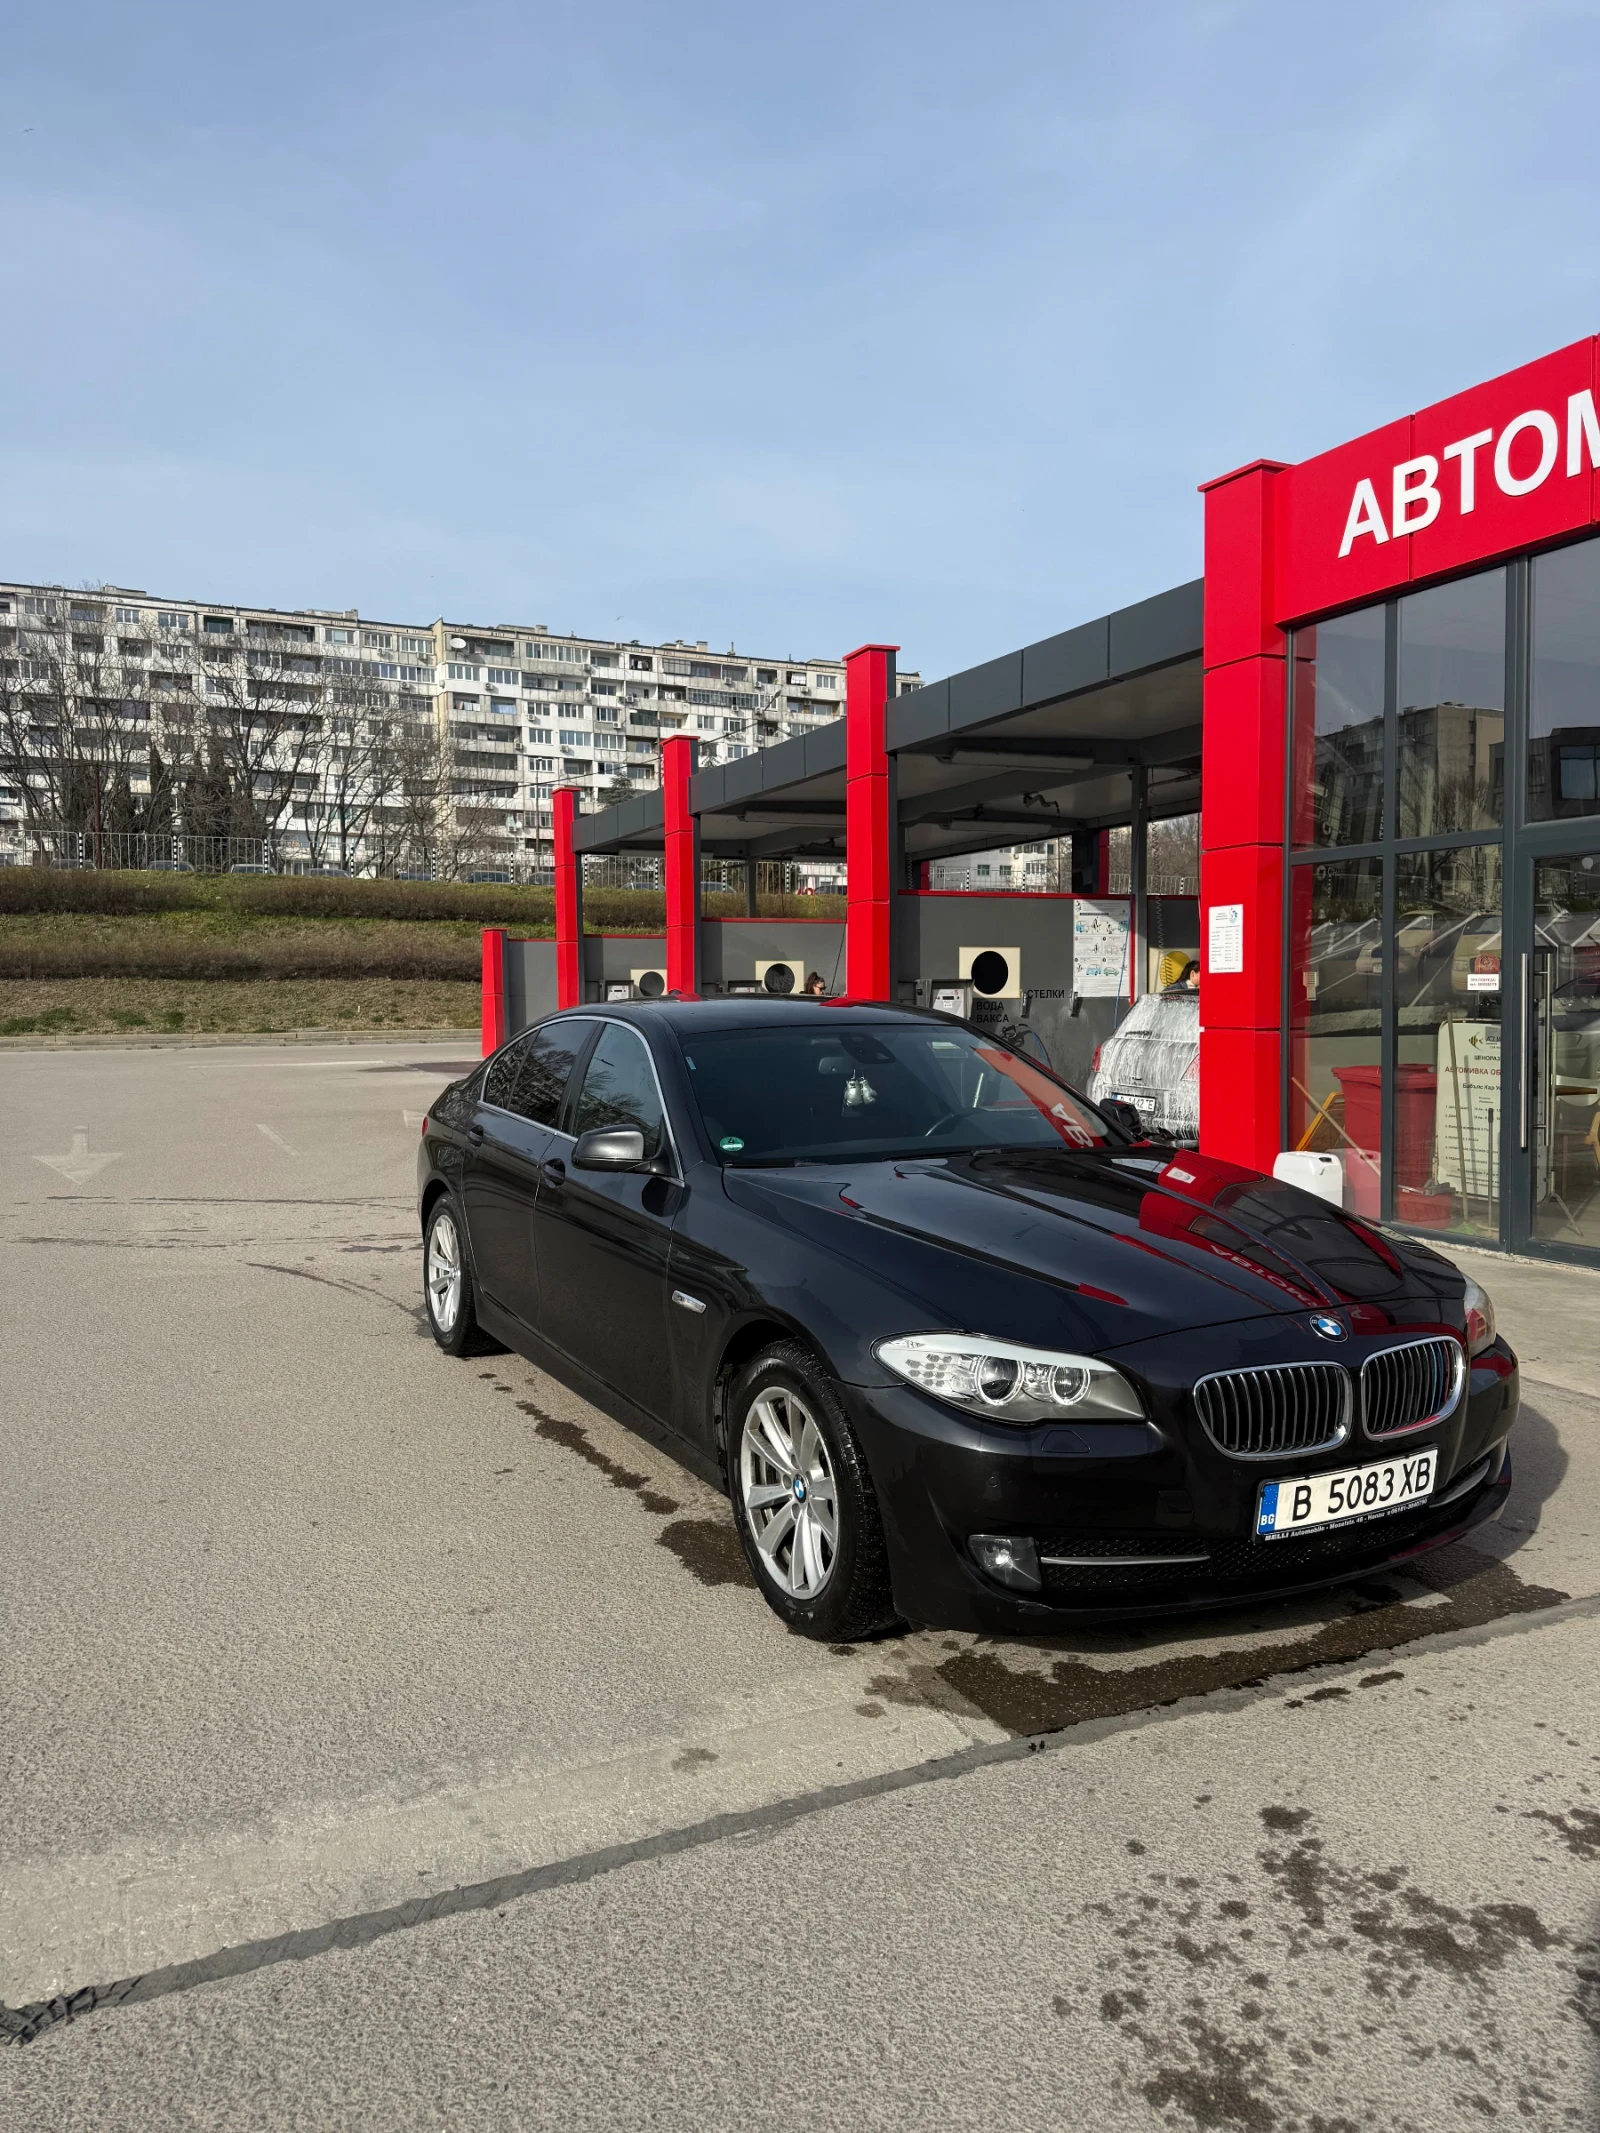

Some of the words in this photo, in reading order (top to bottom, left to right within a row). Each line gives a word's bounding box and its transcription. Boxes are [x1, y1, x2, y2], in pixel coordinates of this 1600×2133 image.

[1027, 989, 1065, 998] СТЕЛКИ
[976, 1001, 1004, 1012] ВОДА
[976, 1013, 1009, 1023] ВАКСА
[1292, 1485, 1312, 1522] B
[1327, 1468, 1395, 1514] 5083
[1399, 1457, 1431, 1498] XB
[1260, 1515, 1275, 1526] BG
[1291, 1526, 1325, 1538] Automobile
